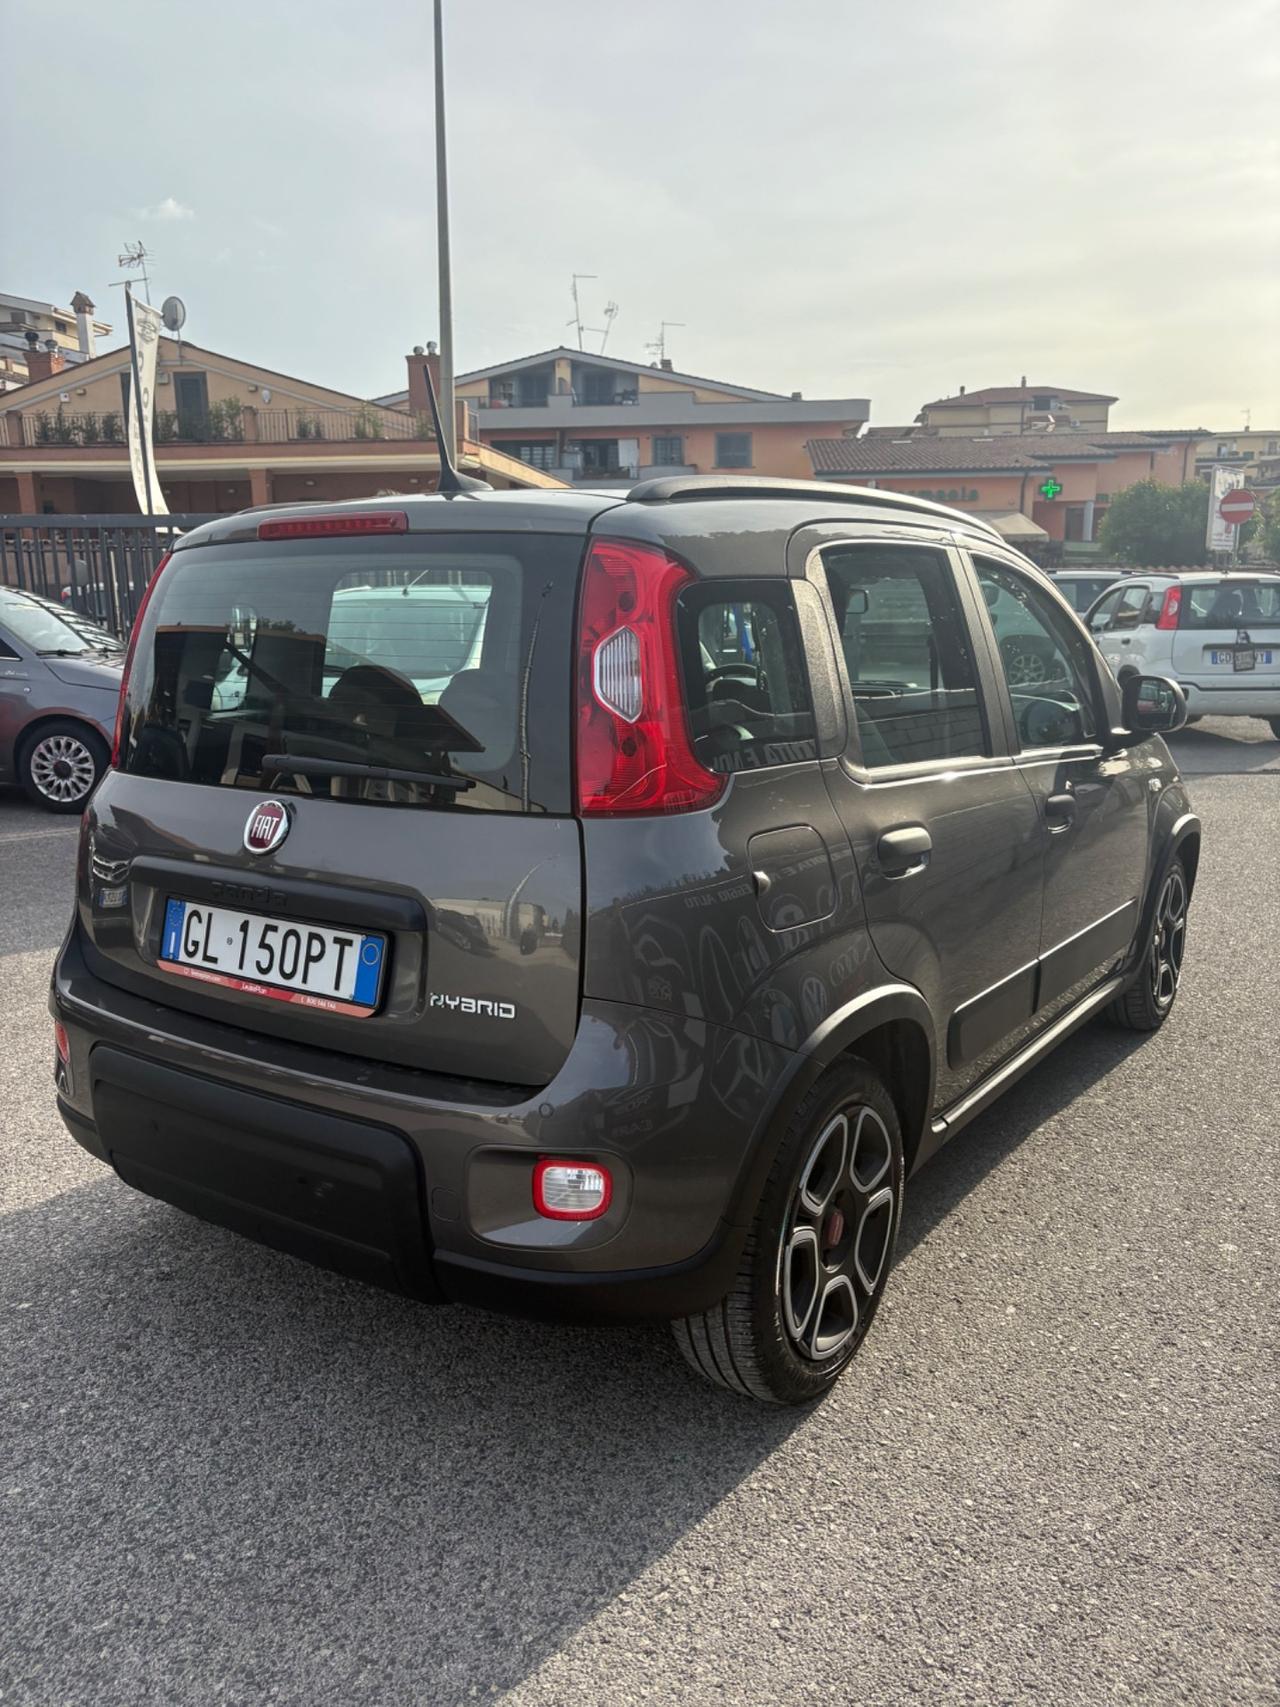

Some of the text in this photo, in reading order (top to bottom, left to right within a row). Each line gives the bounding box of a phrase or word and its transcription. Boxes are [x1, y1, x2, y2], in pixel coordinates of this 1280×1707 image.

[251, 814, 281, 841] FIAT
[183, 909, 219, 965] GL
[238, 919, 354, 992] 150PT
[429, 991, 515, 1019] HYBRID
